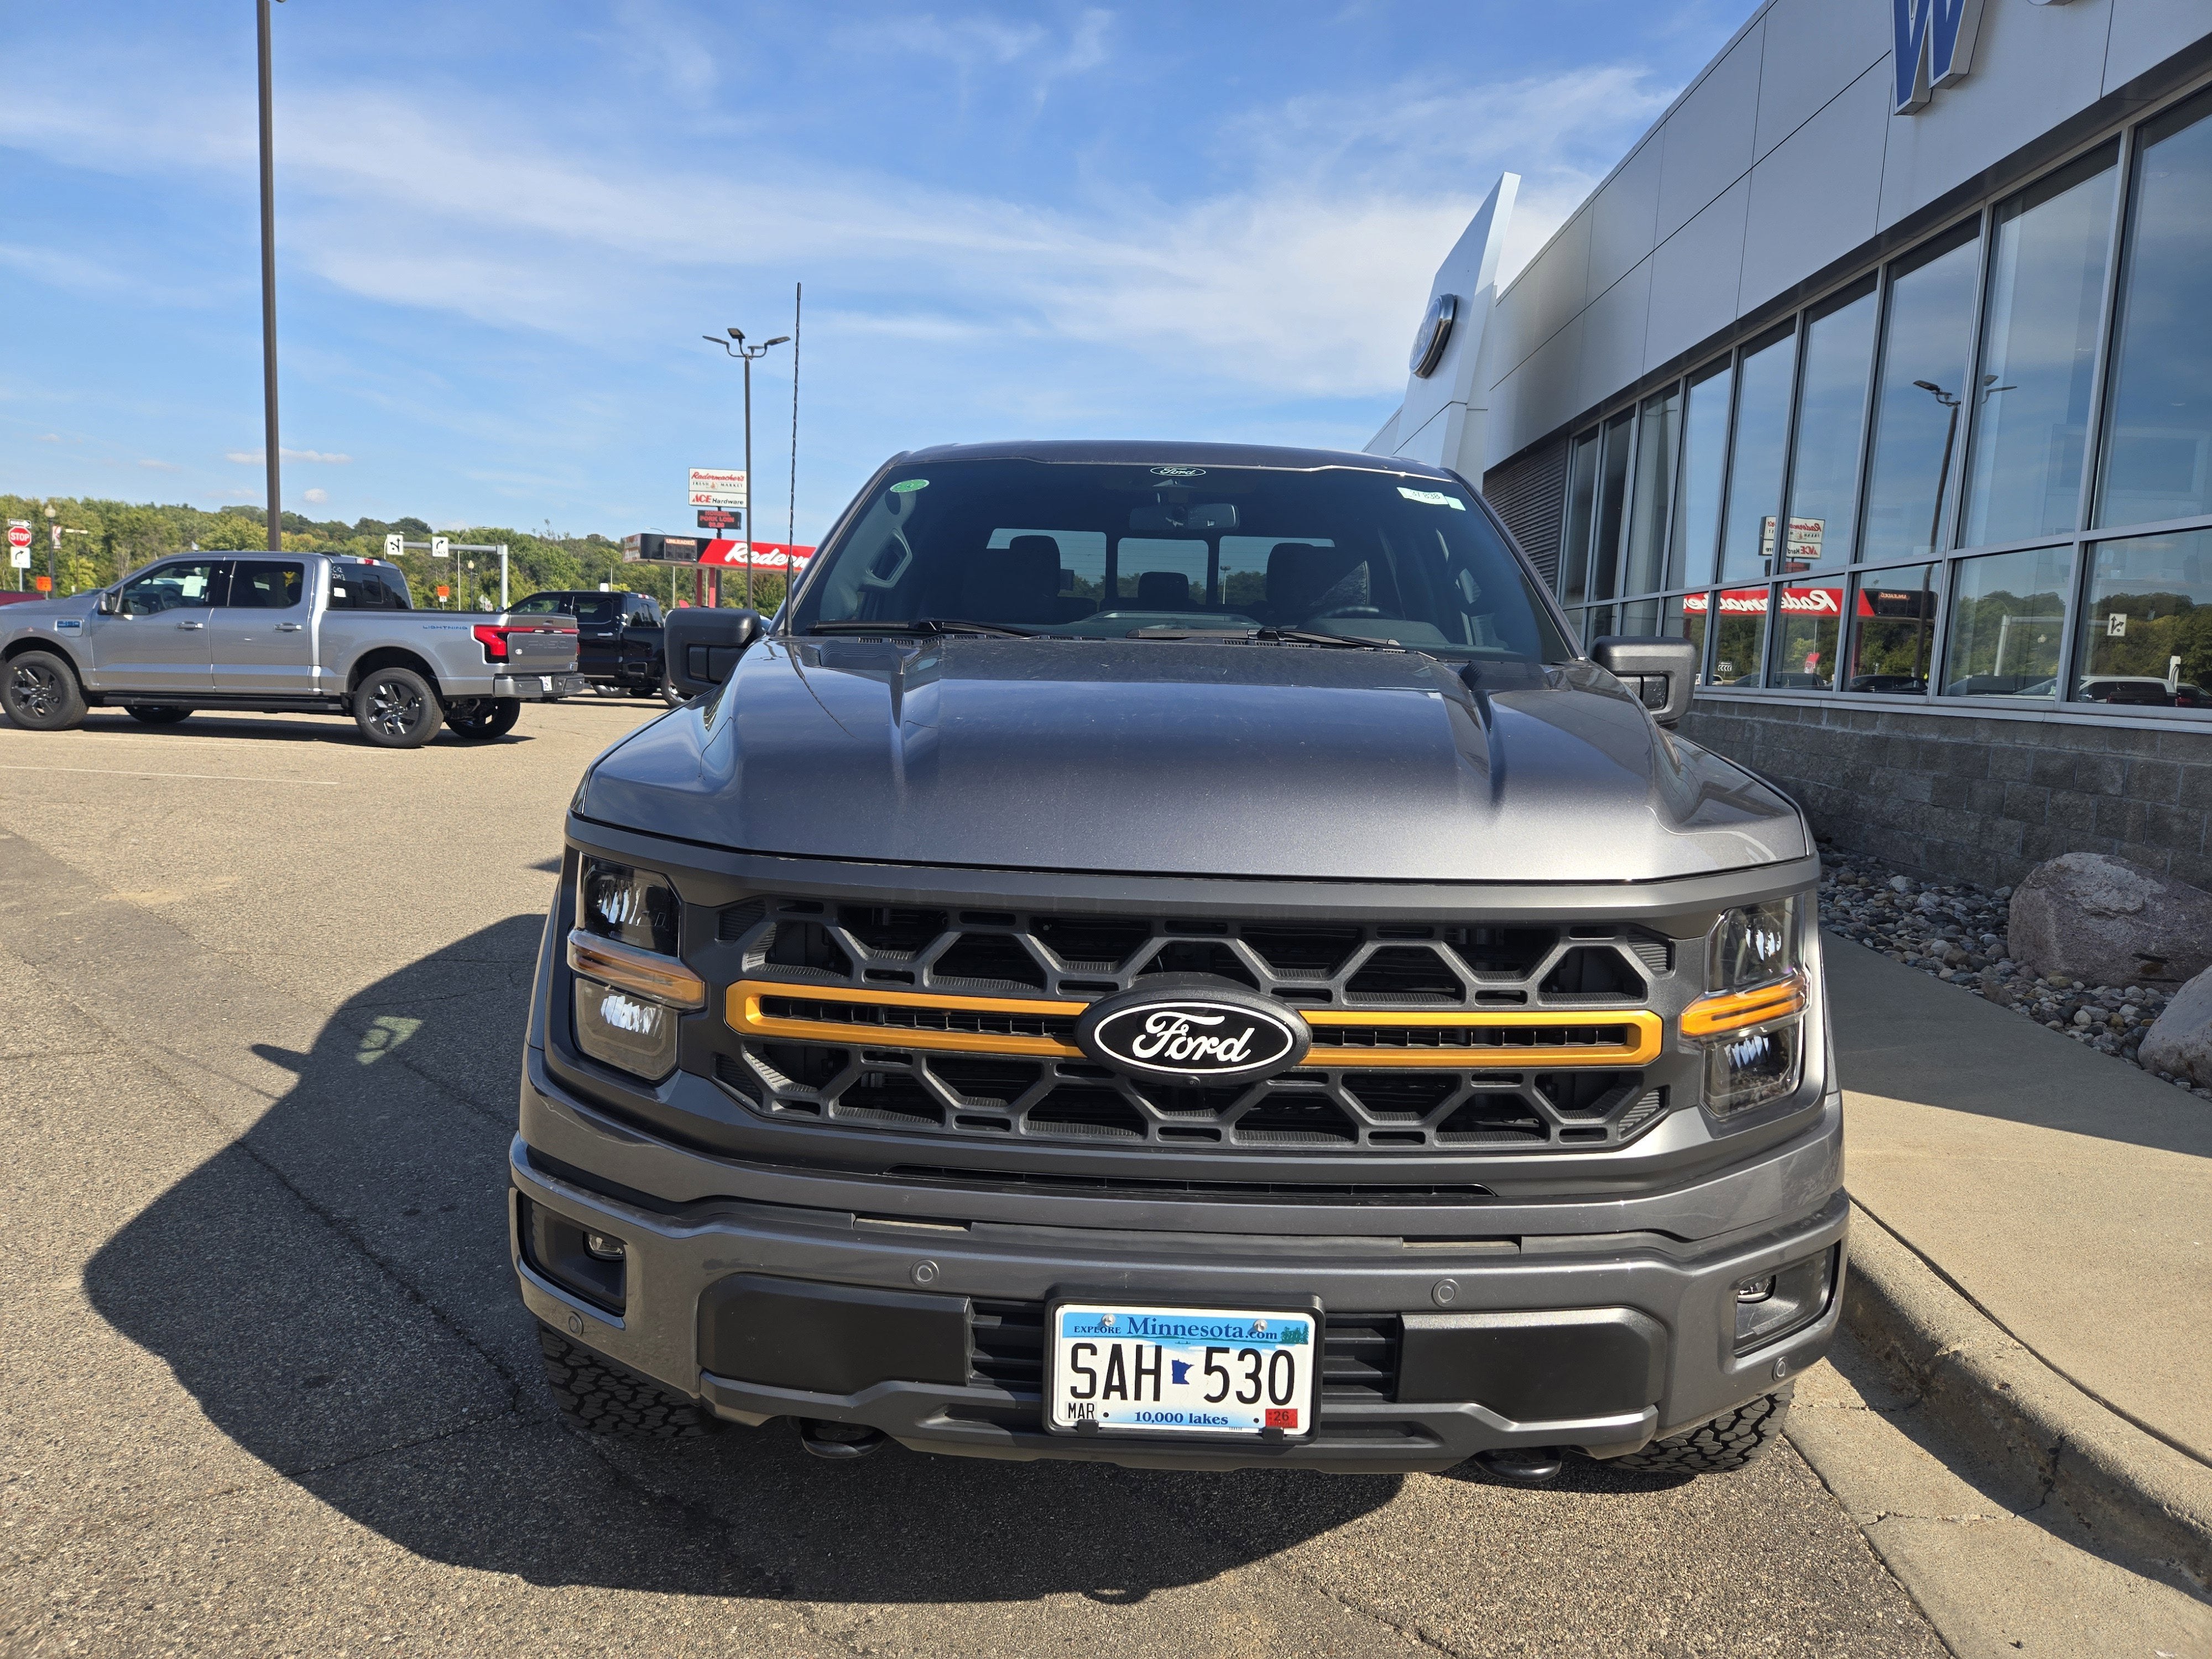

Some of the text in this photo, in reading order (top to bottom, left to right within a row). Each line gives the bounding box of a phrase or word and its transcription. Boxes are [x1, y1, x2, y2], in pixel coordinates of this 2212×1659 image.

[691, 472, 744, 482] Radermacher's
[692, 494, 712, 503] ACE
[11, 531, 30, 541] STOP
[1132, 1011, 1255, 1062] Ford
[1074, 1326, 1121, 1334] EXPLORE
[1070, 1343, 1295, 1406] SAH 530
[1068, 1402, 1094, 1420] MAR
[1274, 1411, 1289, 1421] 26
[1134, 1411, 1228, 1425] 10,000 lakes
